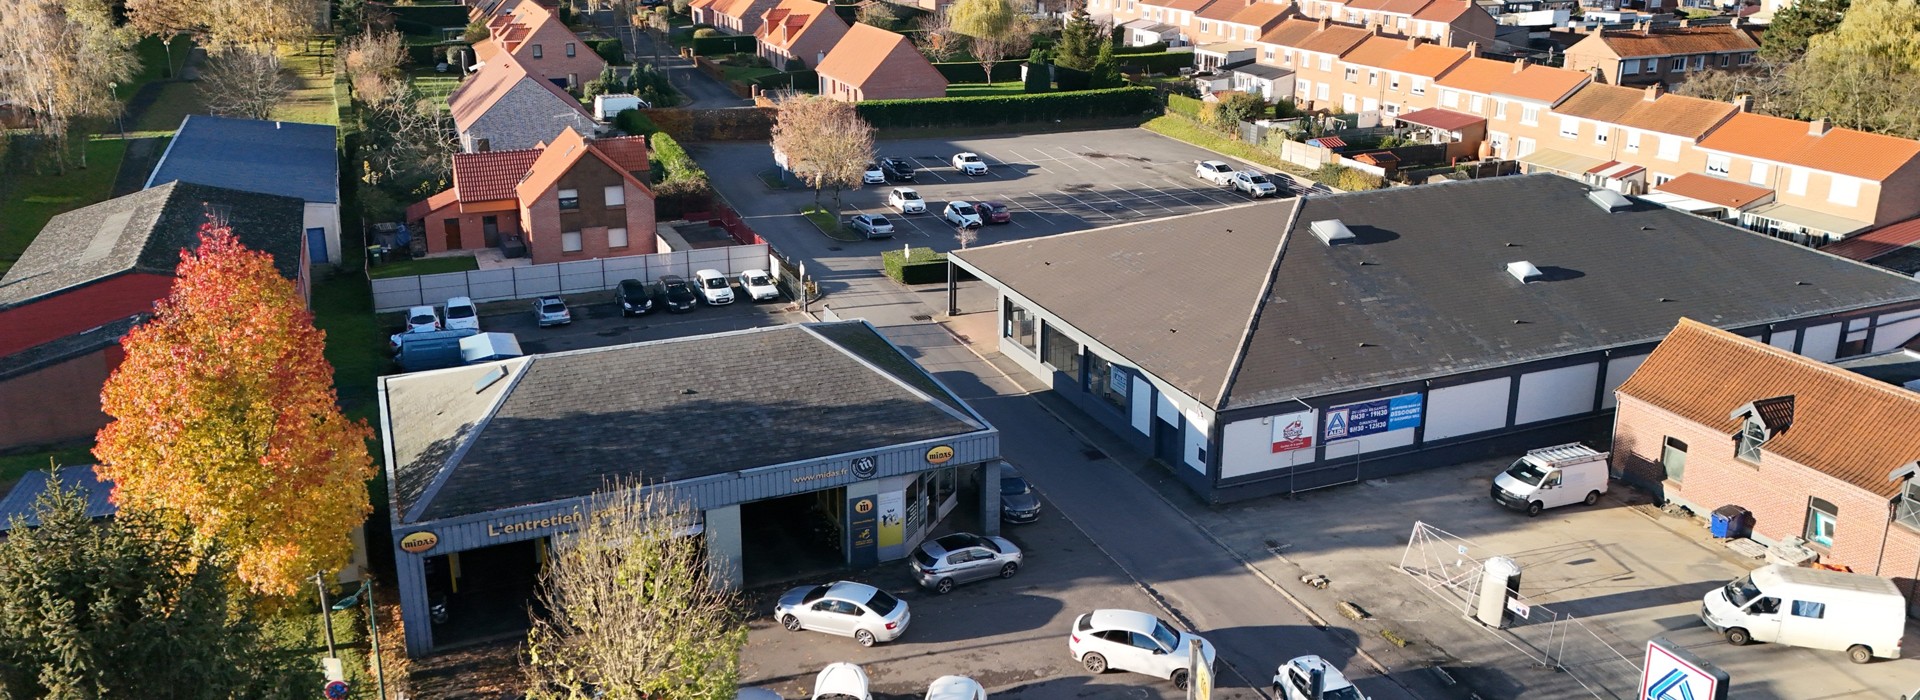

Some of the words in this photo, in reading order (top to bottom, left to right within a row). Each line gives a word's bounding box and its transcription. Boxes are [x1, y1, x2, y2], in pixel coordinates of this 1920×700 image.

[1369, 421, 1387, 430] 12H30
[792, 467, 848, 484] www.midas.fr
[487, 512, 583, 537] L'entretien
